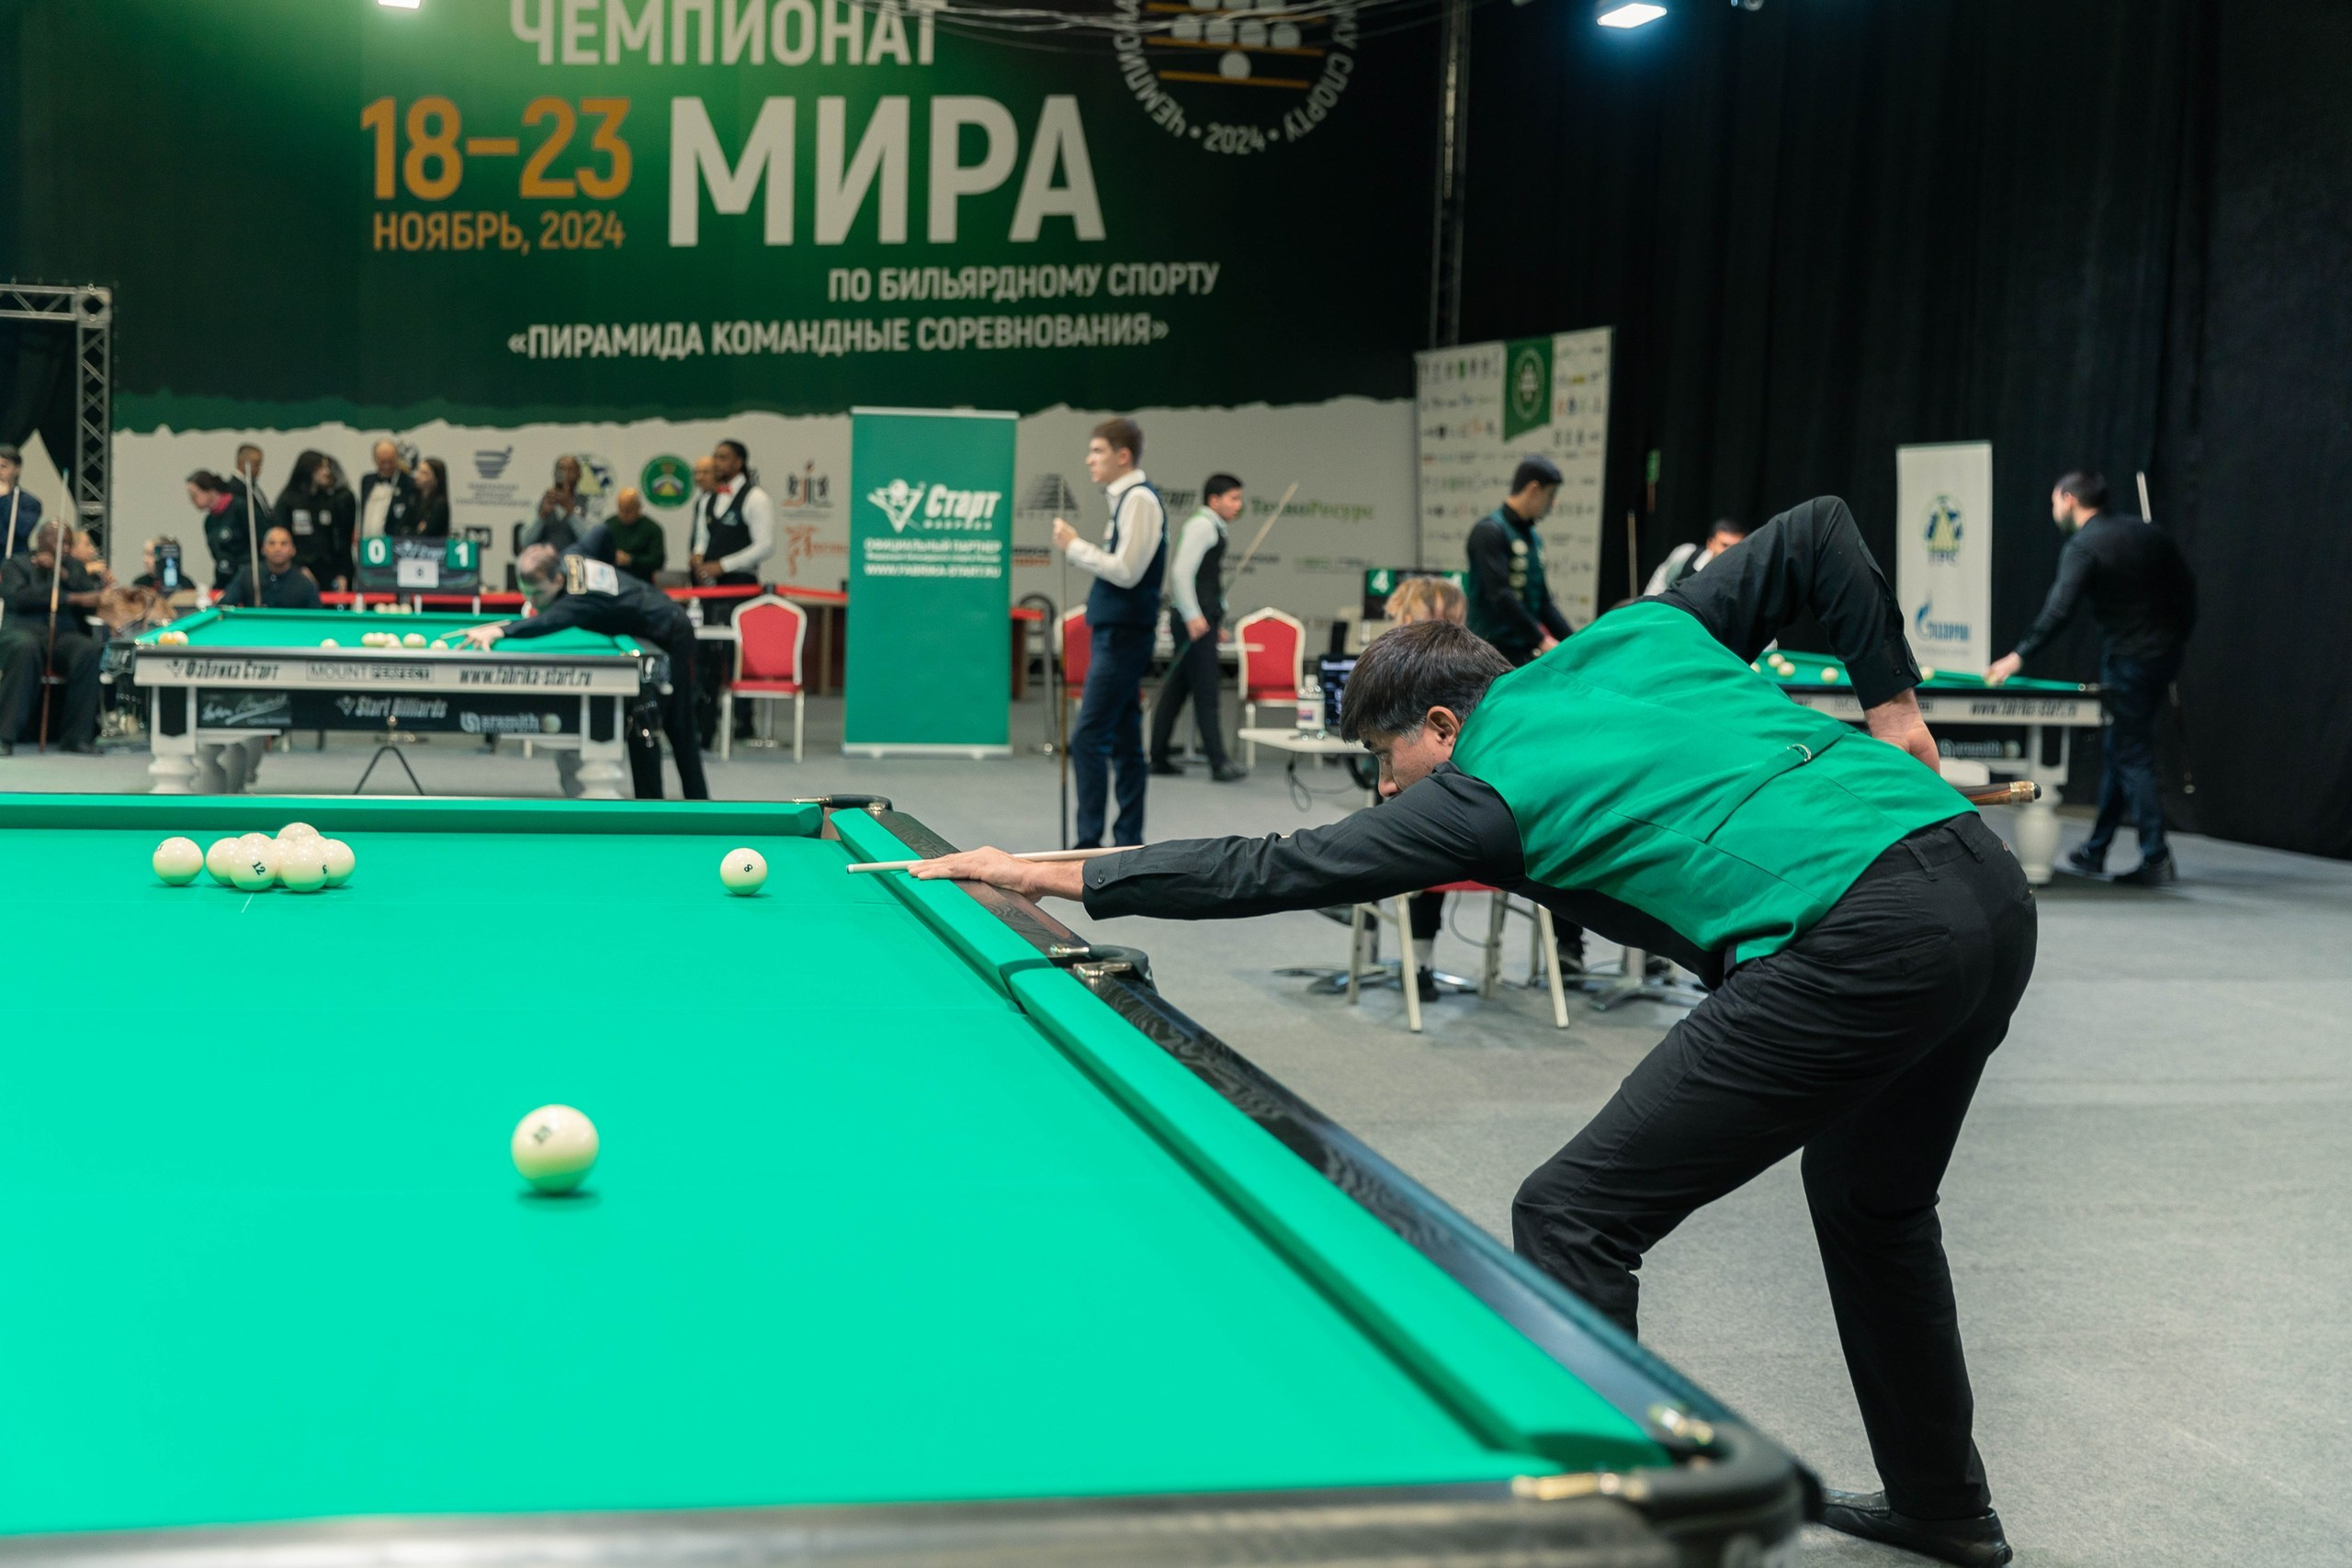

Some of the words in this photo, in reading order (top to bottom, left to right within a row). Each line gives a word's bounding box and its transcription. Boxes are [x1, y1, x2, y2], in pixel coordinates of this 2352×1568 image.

[1203, 121, 1266, 154] 2024
[668, 94, 1106, 247] МИРА
[373, 212, 530, 255] НОЯБРЬ,
[539, 211, 626, 249] 2024
[829, 267, 871, 302] ПО
[878, 264, 1102, 303] БИЛЬЯРДНОМУ
[1107, 262, 1220, 296] СПОРТУ
[507, 322, 704, 361] «ПИРАМИДА
[711, 318, 910, 357] КОМАНДНЫЕ
[916, 312, 1170, 351] СОРЕВНОВАНИЯ»
[924, 483, 1002, 525] Старт
[368, 538, 386, 564] 0
[455, 541, 469, 568] 1
[253, 861, 266, 876] 12
[744, 863, 753, 873] 8
